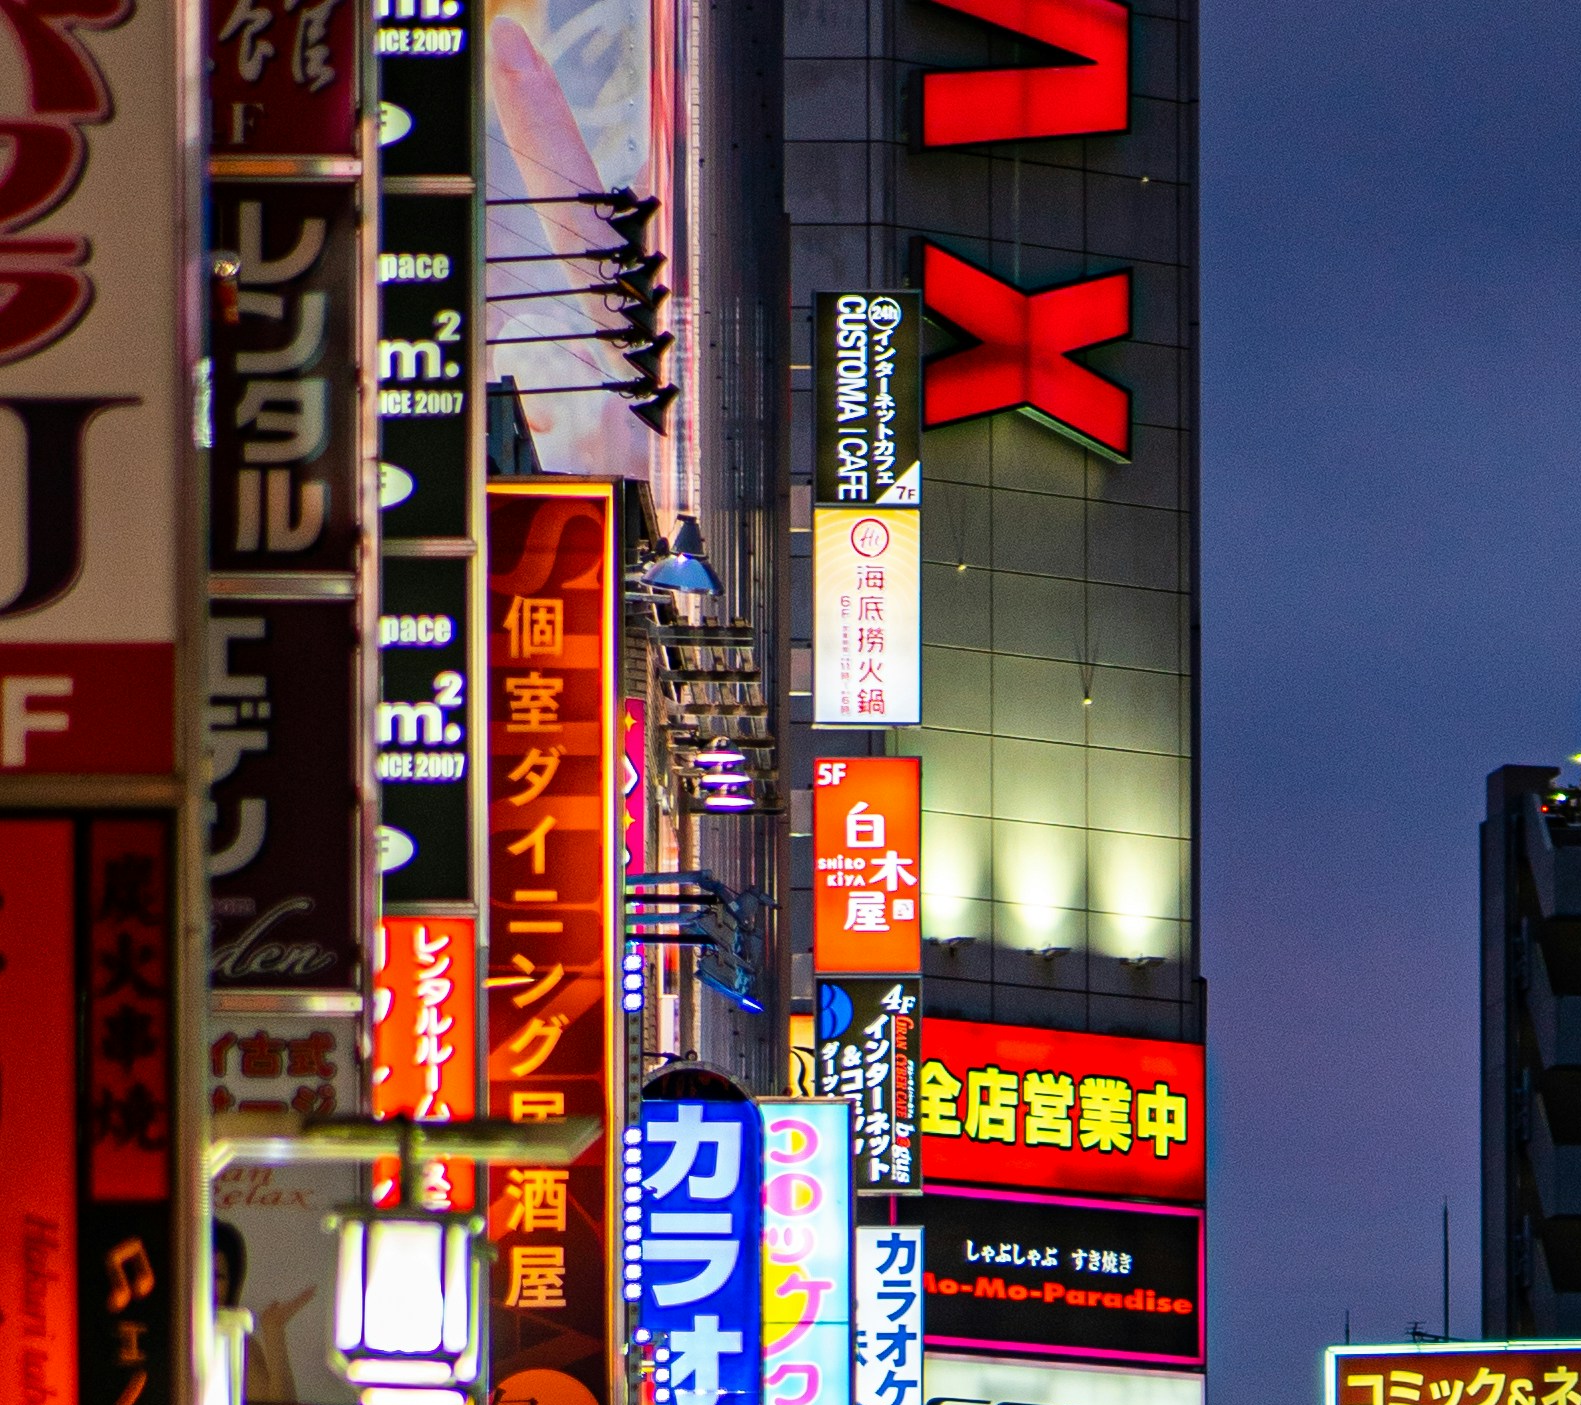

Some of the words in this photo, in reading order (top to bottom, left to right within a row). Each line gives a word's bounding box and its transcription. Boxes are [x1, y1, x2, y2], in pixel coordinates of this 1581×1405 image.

[414, 29, 462, 54] 2007
[836, 294, 869, 424] CUSTOMA
[415, 391, 463, 415] 2007
[836, 437, 869, 501] CAFE
[895, 485, 916, 500] 7F
[414, 754, 464, 779] 2007
[817, 762, 848, 787] 5F
[881, 983, 917, 1015] 4F
[862, 1013, 891, 1183] インターネット
[920, 1059, 1189, 1159] 全店営業中
[964, 1238, 1060, 1269] しゃぶしゃぶ
[1071, 1248, 1134, 1275] すき焼き
